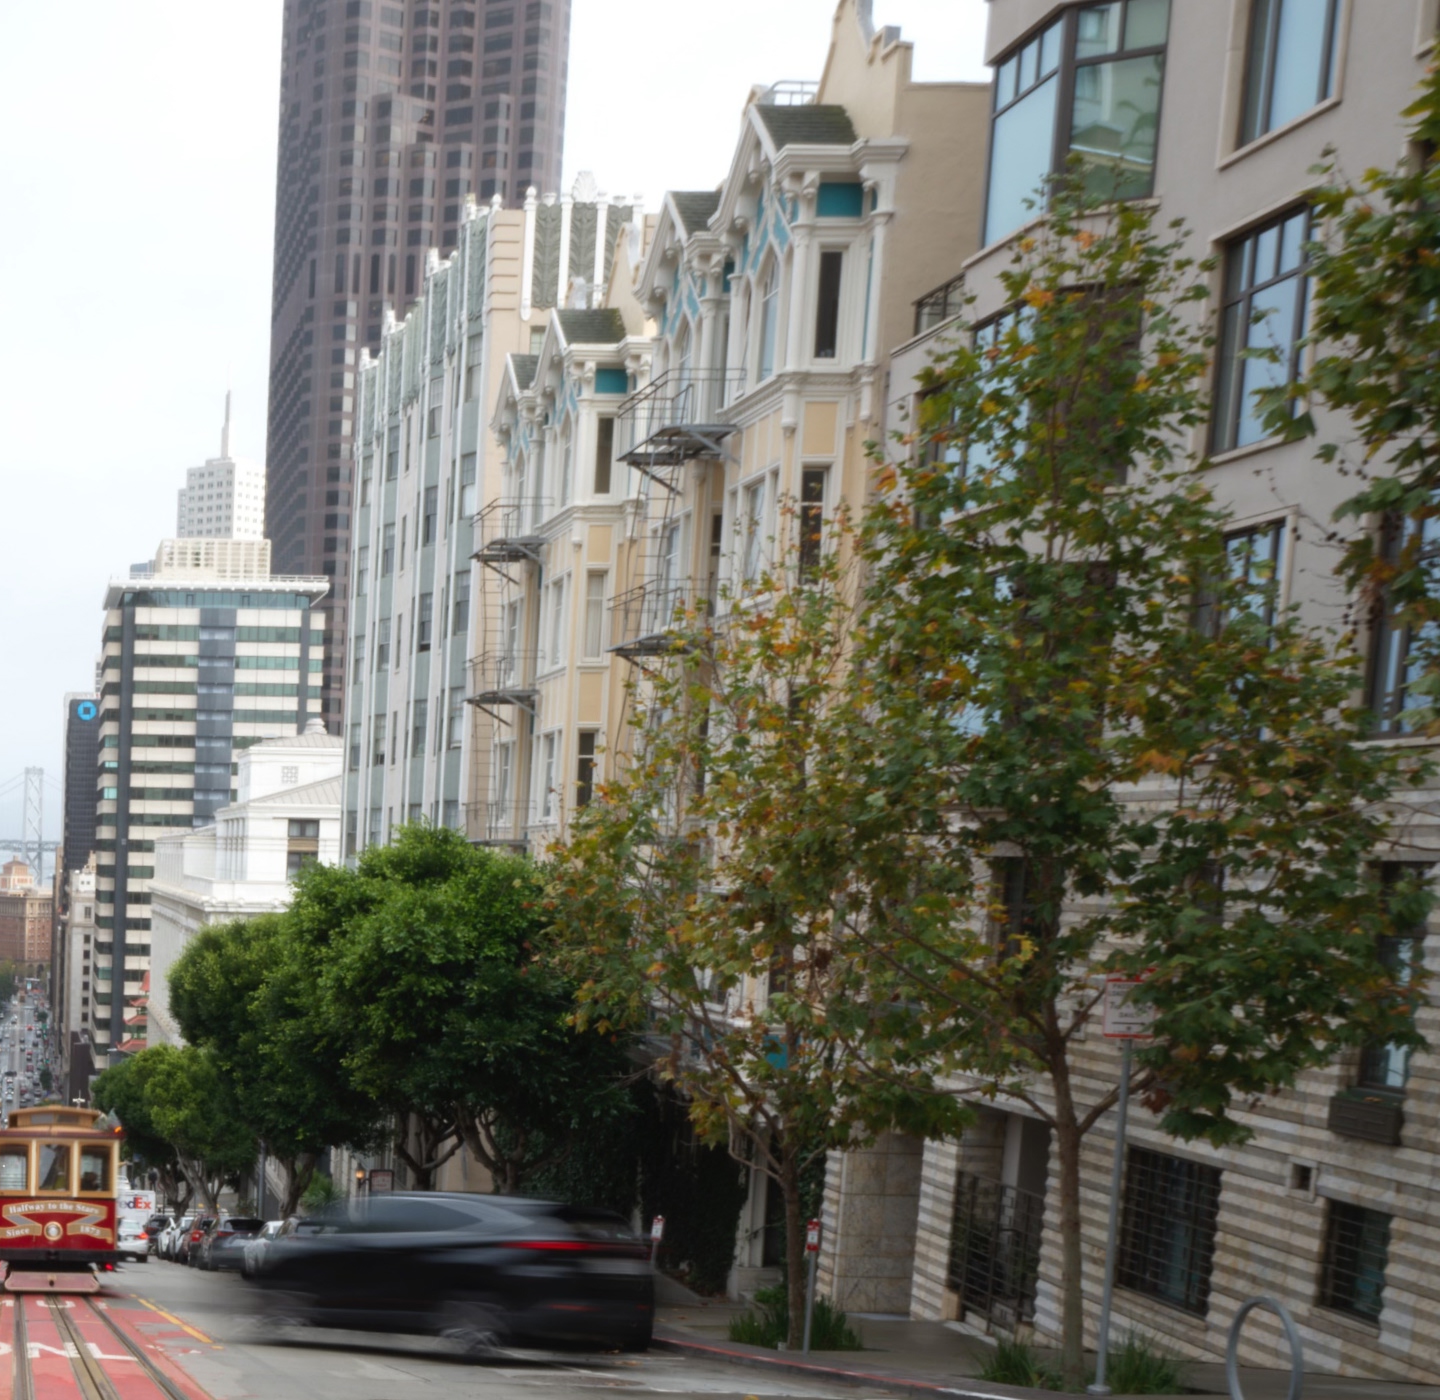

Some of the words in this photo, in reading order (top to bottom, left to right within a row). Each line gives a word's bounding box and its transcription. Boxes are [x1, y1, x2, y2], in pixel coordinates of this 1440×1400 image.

[9, 1203, 45, 1214] Halfway
[48, 1202, 58, 1210] to
[59, 1203, 73, 1211] the
[75, 1204, 99, 1214] Stars
[119, 1196, 152, 1210] edEx
[6, 1228, 30, 1237] Since
[80, 1225, 101, 1235] 1873
